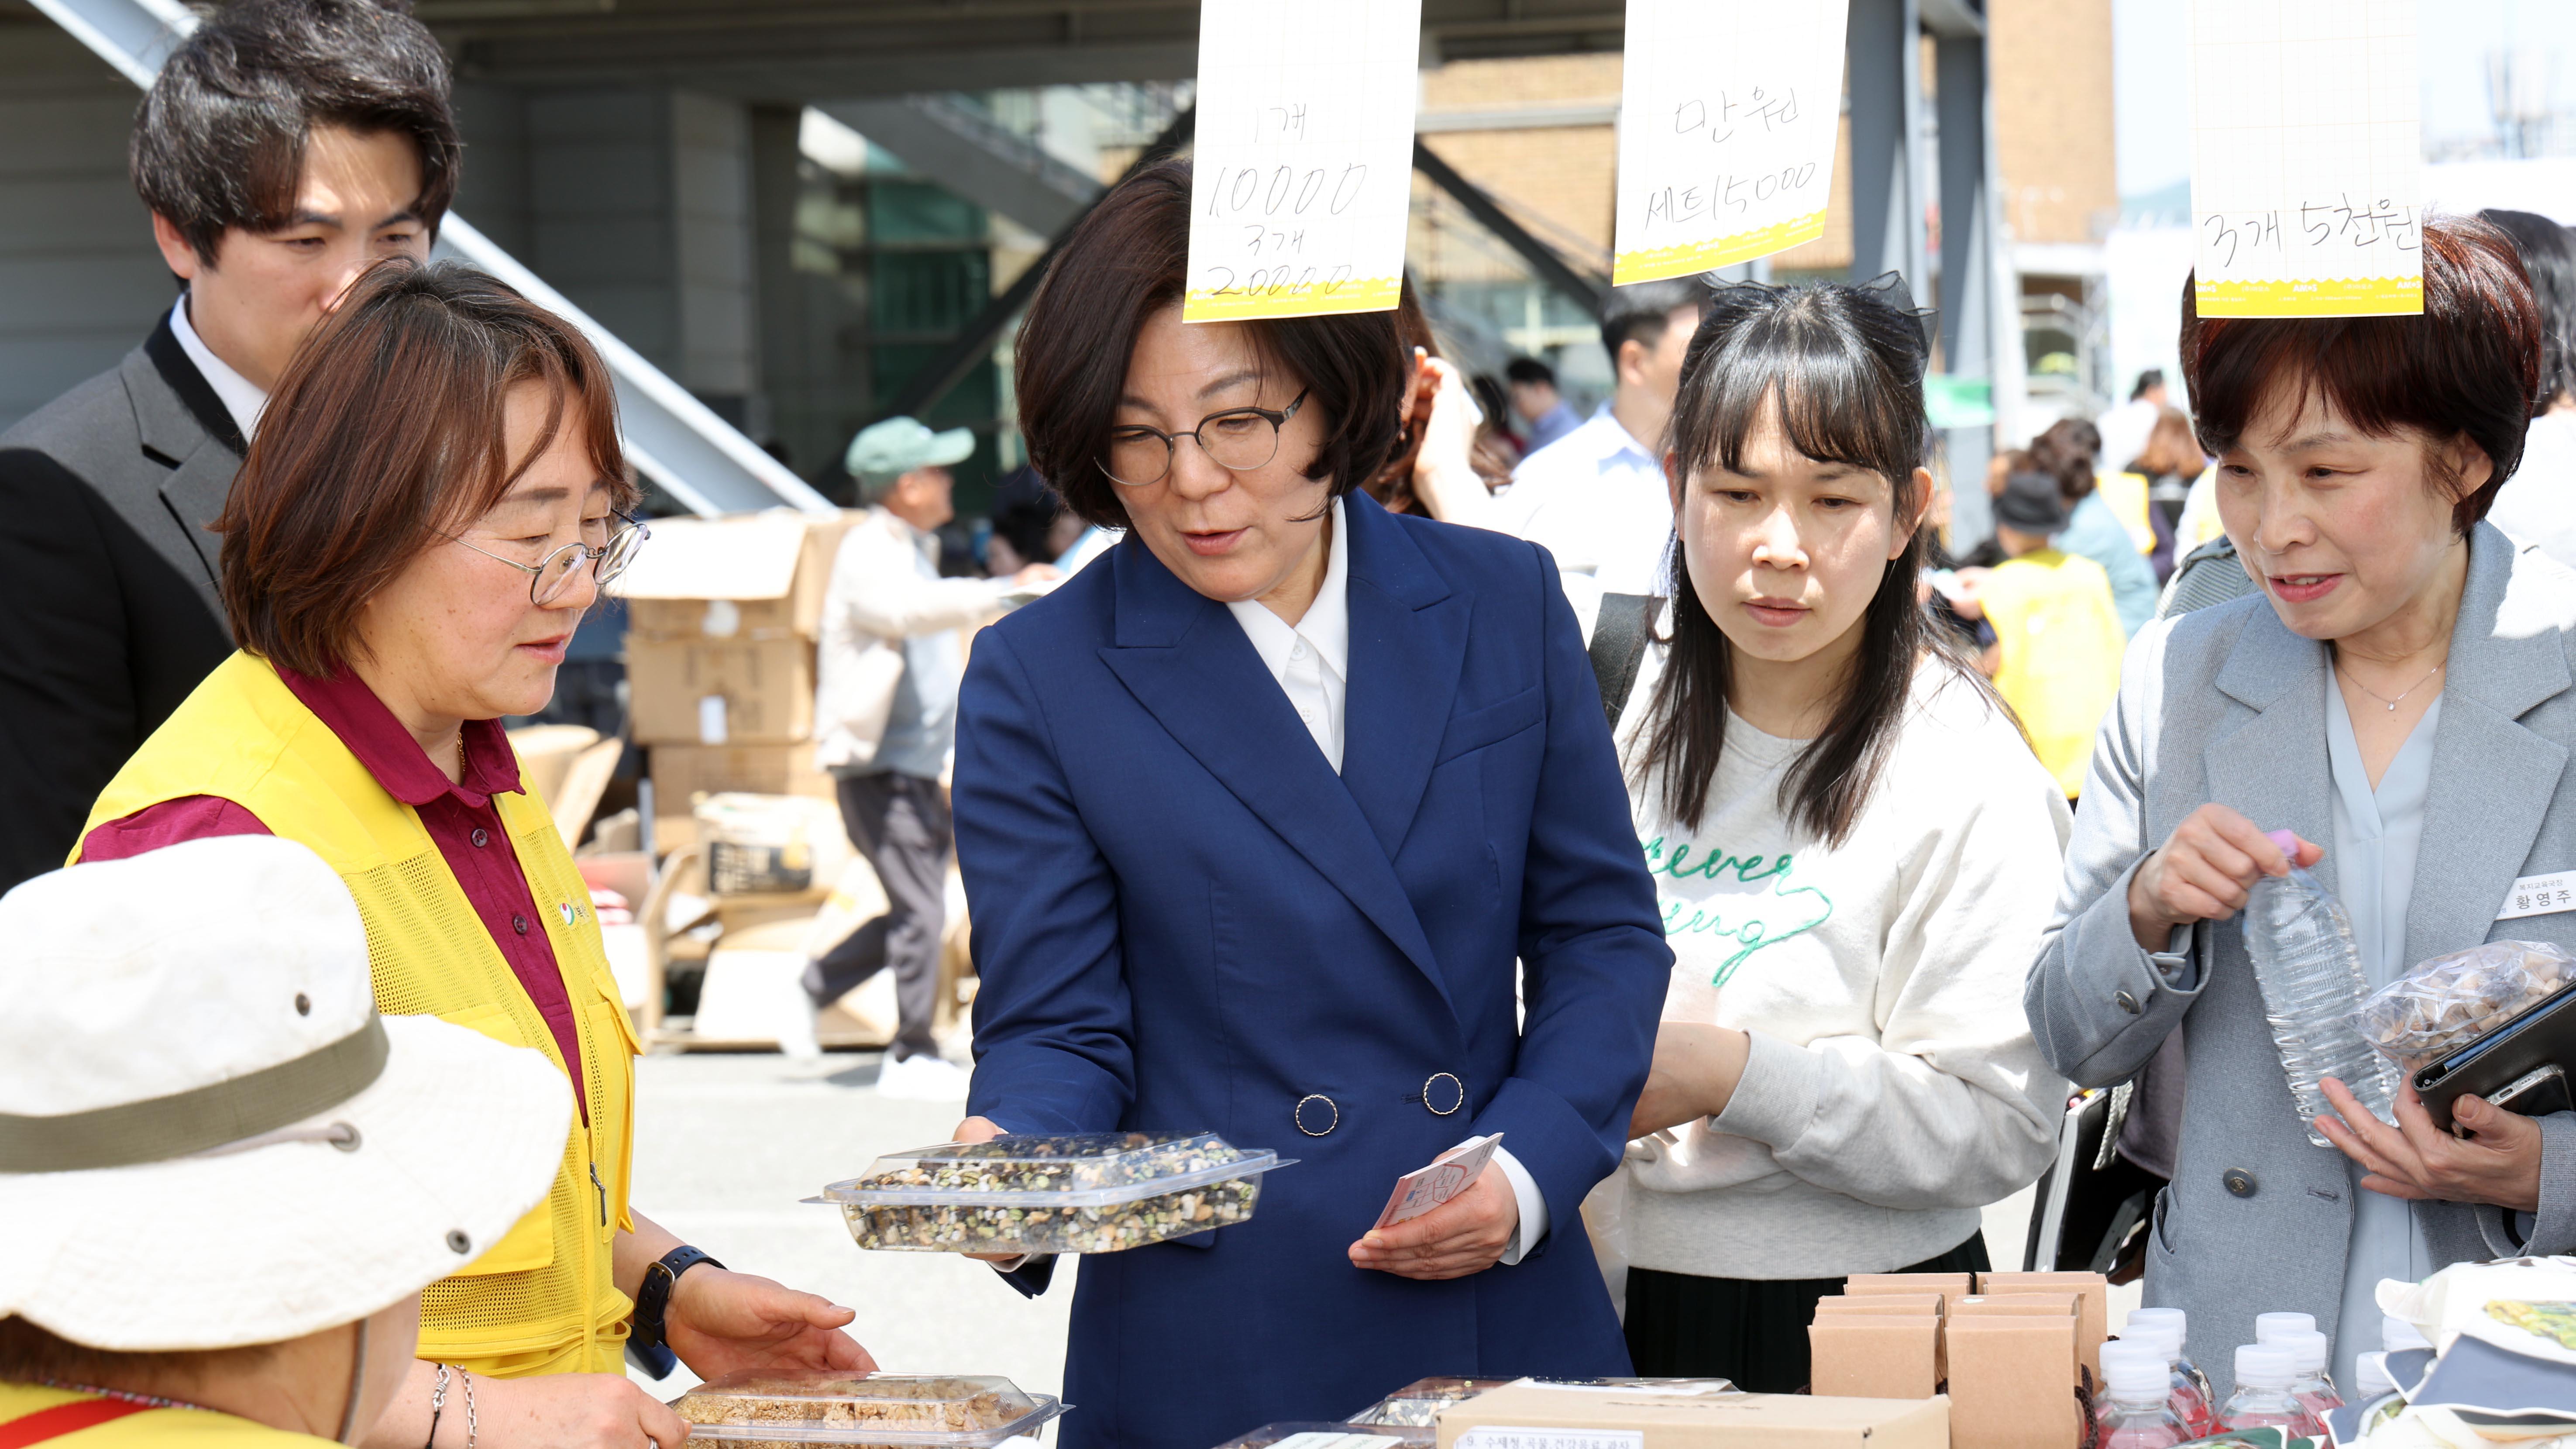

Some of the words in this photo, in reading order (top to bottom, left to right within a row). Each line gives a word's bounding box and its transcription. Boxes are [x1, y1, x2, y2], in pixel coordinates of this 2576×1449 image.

[1254, 103, 1306, 143] 1개
[1675, 86, 1799, 143] 만원
[1209, 162, 1367, 218] 10000
[1244, 225, 1304, 256] 3개
[2205, 210, 2281, 267] 3개
[2300, 193, 2421, 251] 5천원
[1207, 265, 1352, 296] 20000
[2519, 879, 2562, 891] 복지교육국장
